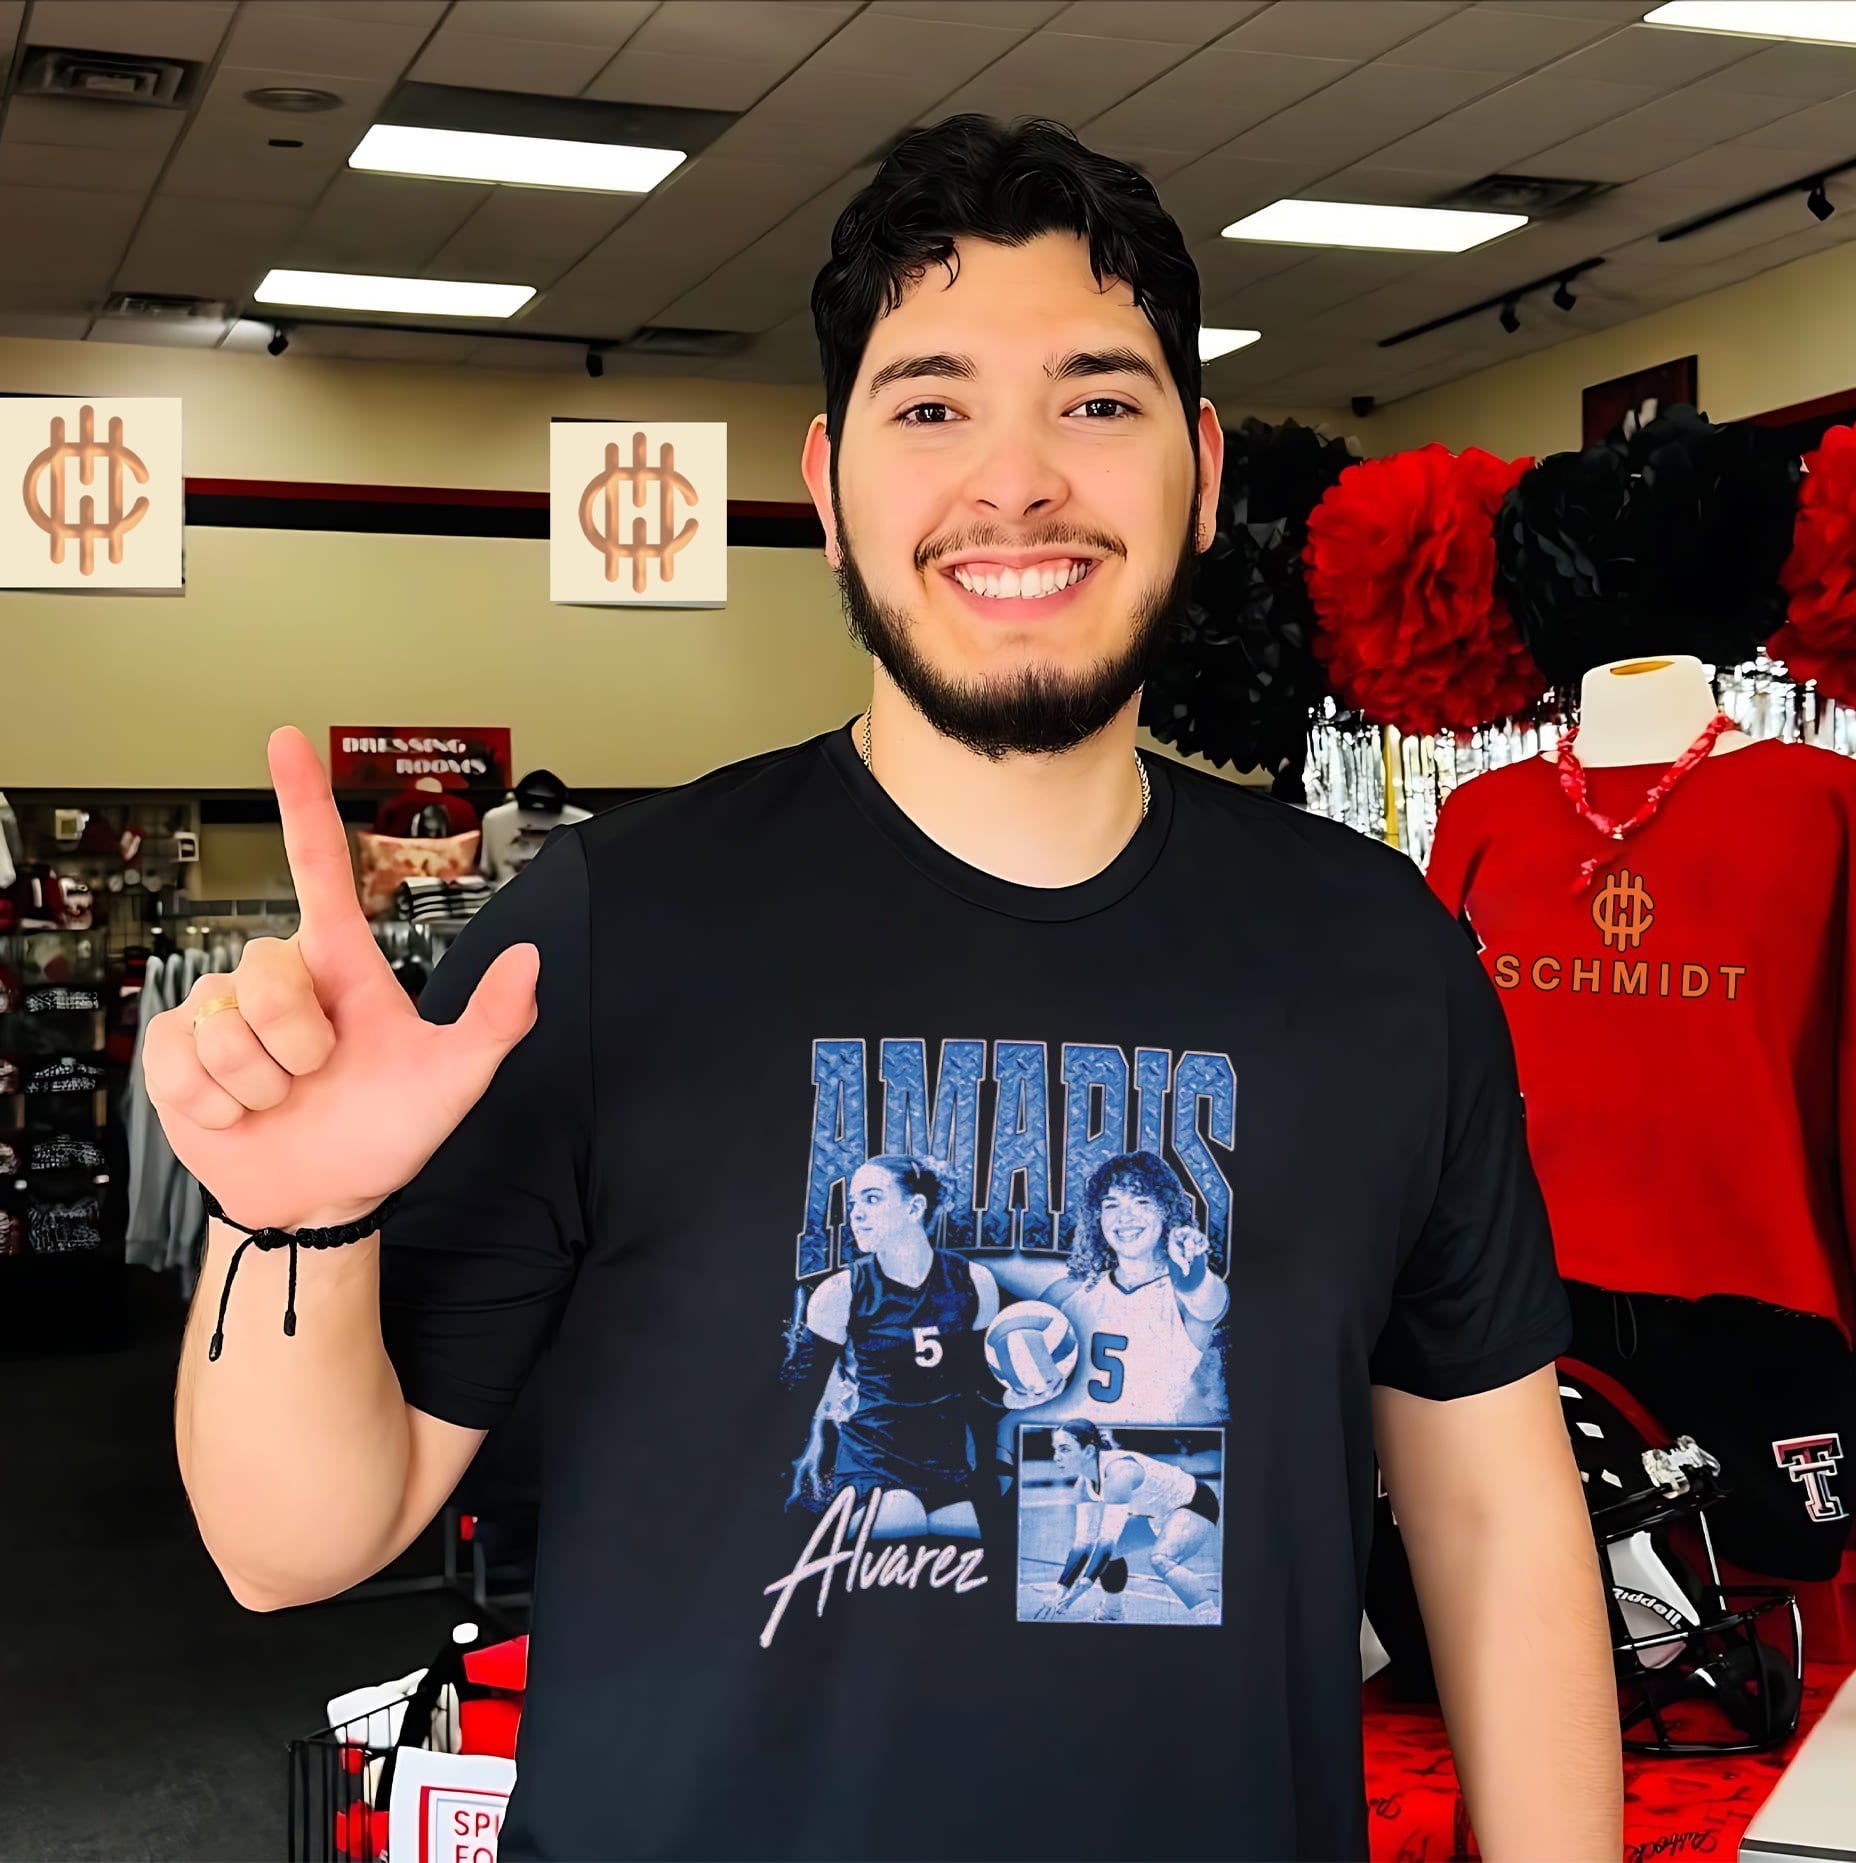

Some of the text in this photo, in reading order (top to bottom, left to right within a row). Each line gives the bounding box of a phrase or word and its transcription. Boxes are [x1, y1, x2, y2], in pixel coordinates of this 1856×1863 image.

[342, 737, 467, 754] DRESSING
[395, 758, 488, 775] ROOMS
[1494, 953, 1747, 1000] SCHMIDT
[912, 1326, 944, 1368] 5
[1087, 1331, 1128, 1404] 5
[759, 1485, 989, 1649] Alvarez
